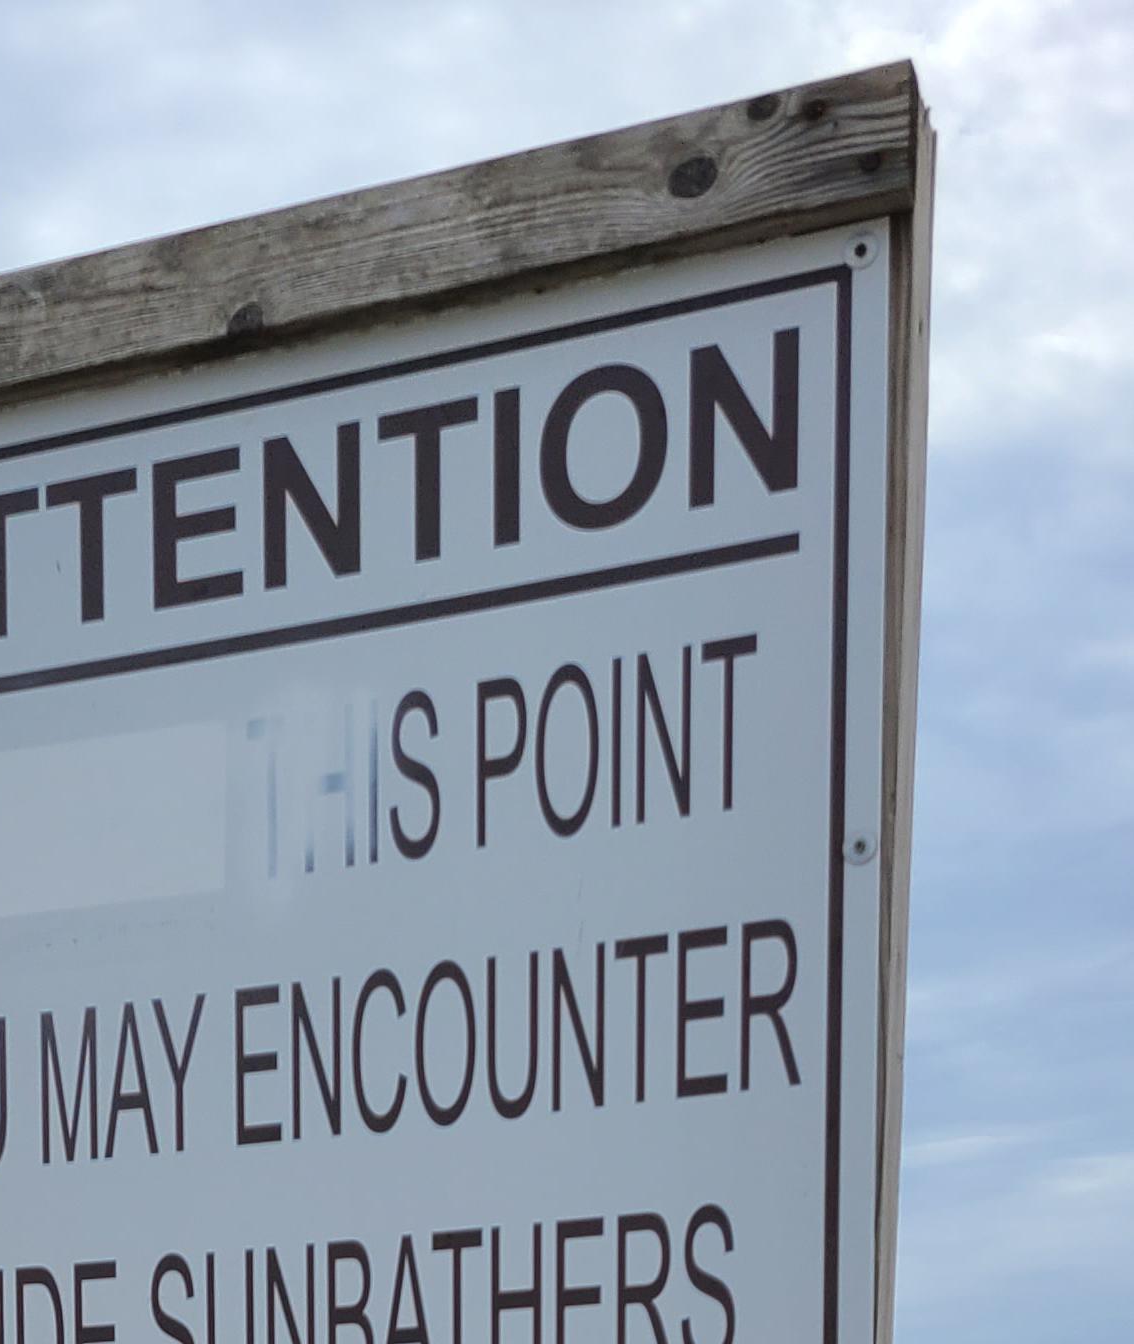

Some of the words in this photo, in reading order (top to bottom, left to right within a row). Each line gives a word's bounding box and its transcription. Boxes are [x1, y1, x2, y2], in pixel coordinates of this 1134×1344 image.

[476, 632, 758, 849] POINT
[40, 992, 206, 1166] MAY
[235, 917, 802, 1147] ENCOUNTER
